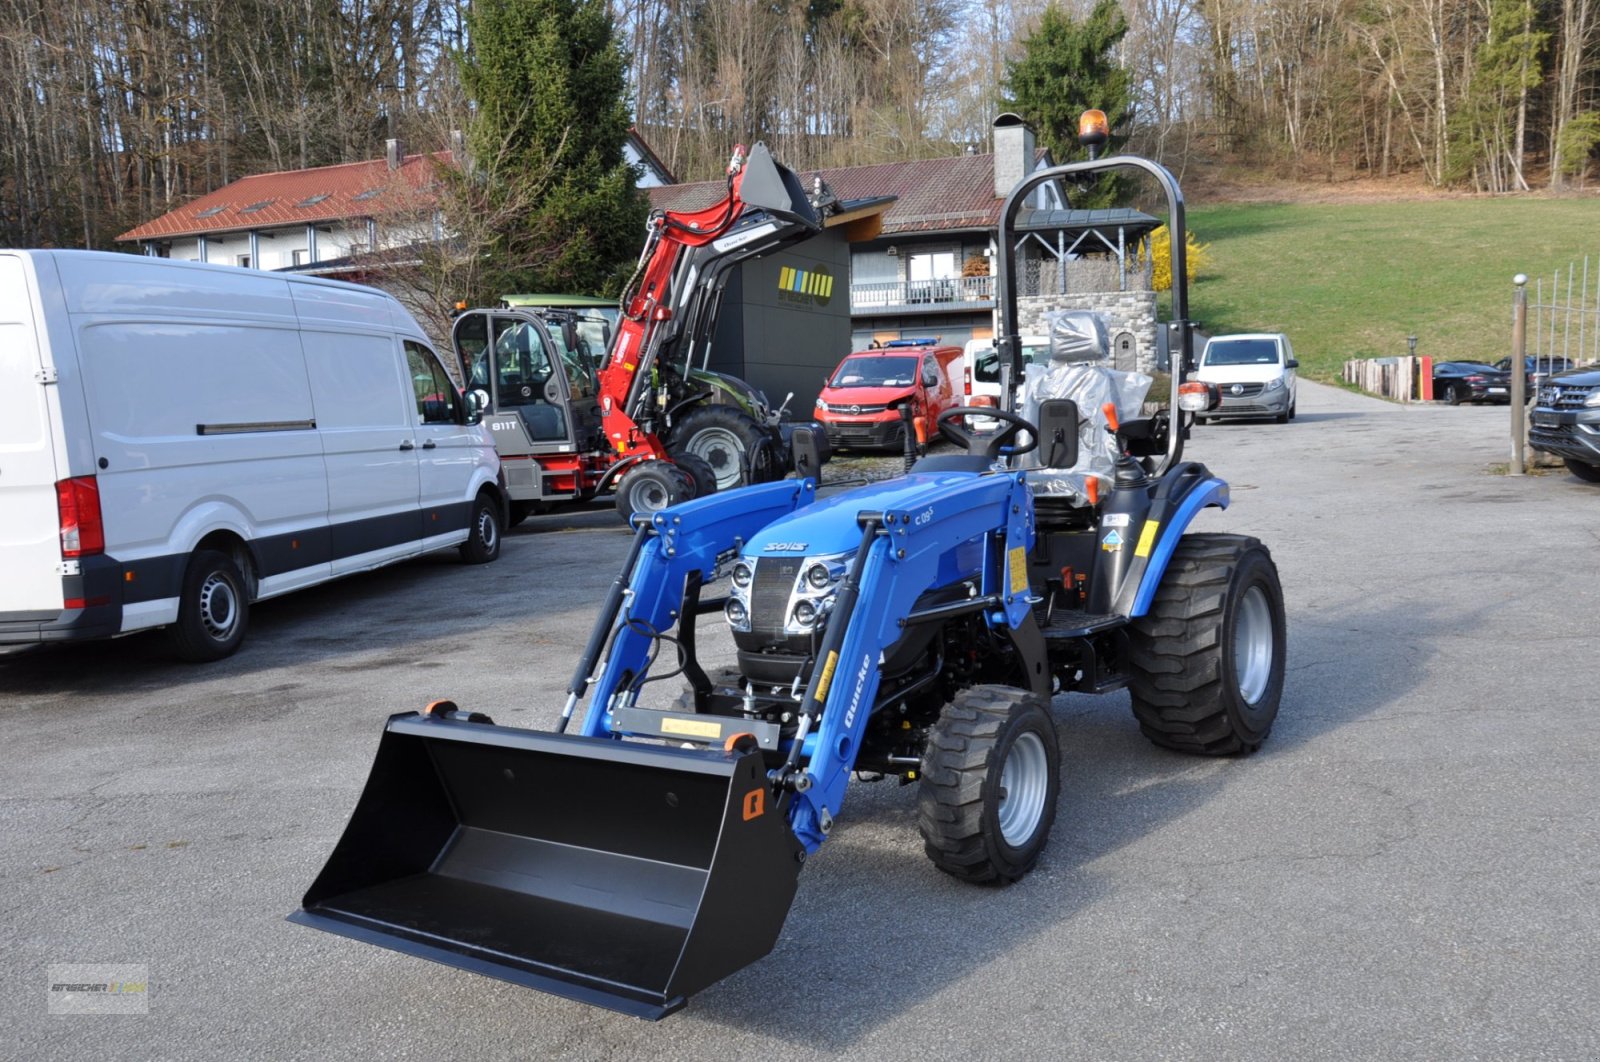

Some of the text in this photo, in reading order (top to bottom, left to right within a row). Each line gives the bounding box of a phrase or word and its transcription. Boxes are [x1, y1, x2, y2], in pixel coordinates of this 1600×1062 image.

[492, 421, 517, 431] 811T
[764, 543, 808, 552] SOLIS
[844, 653, 870, 729] Quicke
